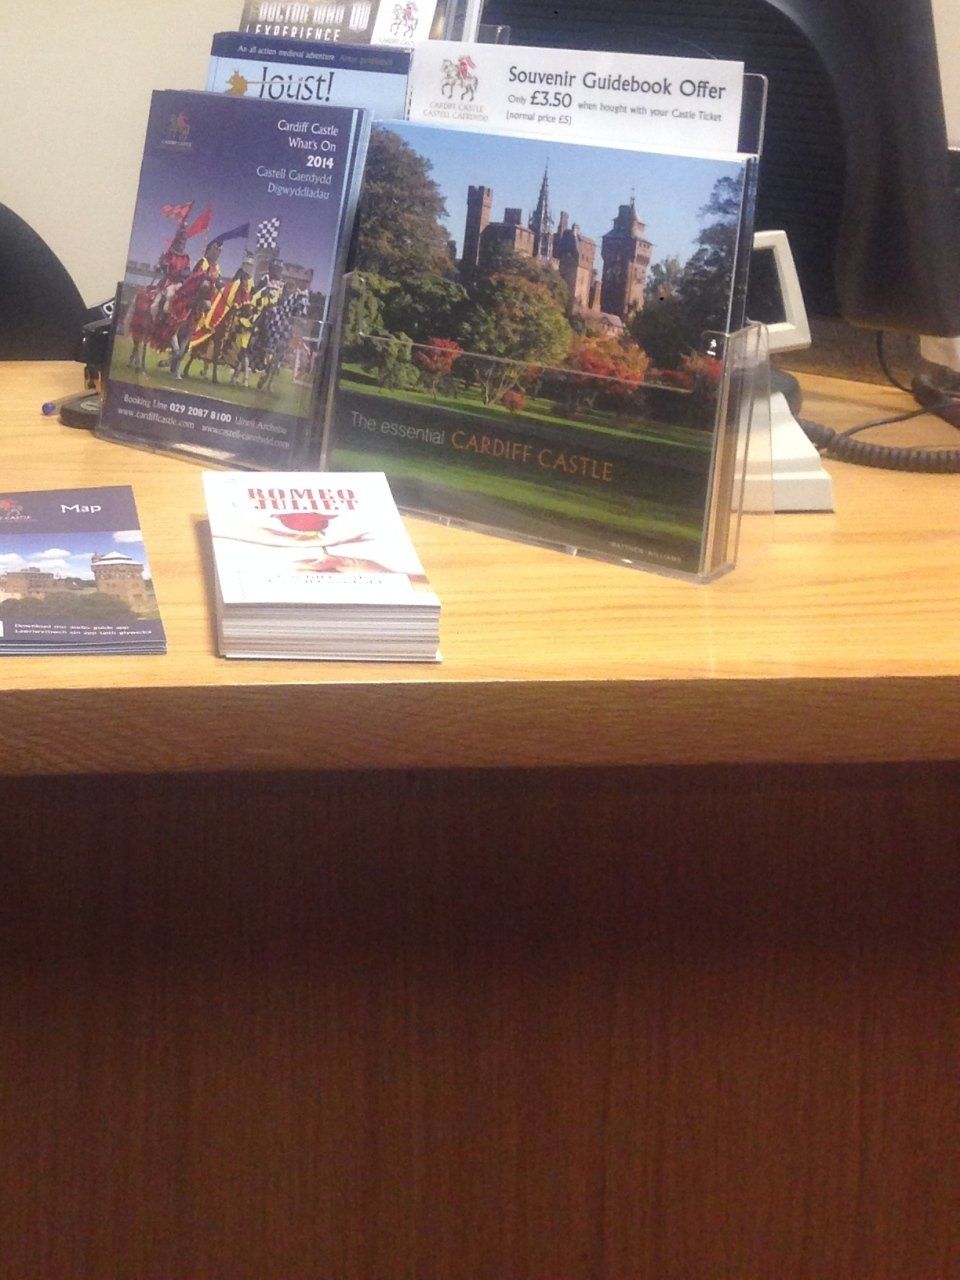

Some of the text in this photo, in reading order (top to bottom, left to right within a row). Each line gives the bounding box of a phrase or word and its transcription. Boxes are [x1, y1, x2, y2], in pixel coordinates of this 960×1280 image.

[258, 47, 276, 55] action
[278, 49, 305, 58] medieval
[306, 52, 335, 60] adventure
[259, 67, 336, 102] Joust!
[509, 65, 727, 100] Souvenir Guidebook Offer
[507, 90, 722, 122] Only £3.50 when bought with your Castle Ticket
[538, 113, 556, 124] price
[277, 119, 339, 136] Cardiff Castle
[288, 136, 336, 152] What's On
[306, 155, 334, 169] 2014
[256, 165, 332, 185] Castell Caerdydd
[268, 181, 330, 200] Digwyddiadau
[123, 393, 151, 408] Booking
[152, 399, 168, 410] Line
[169, 402, 186, 413] 029
[187, 406, 209, 417] 2087
[210, 410, 232, 423] 8100
[351, 410, 614, 482] The essential CARDIFF CASTLE
[247, 488, 356, 500] ROMEO
[61, 504, 102, 513] Map
[254, 499, 359, 510] JULIET
